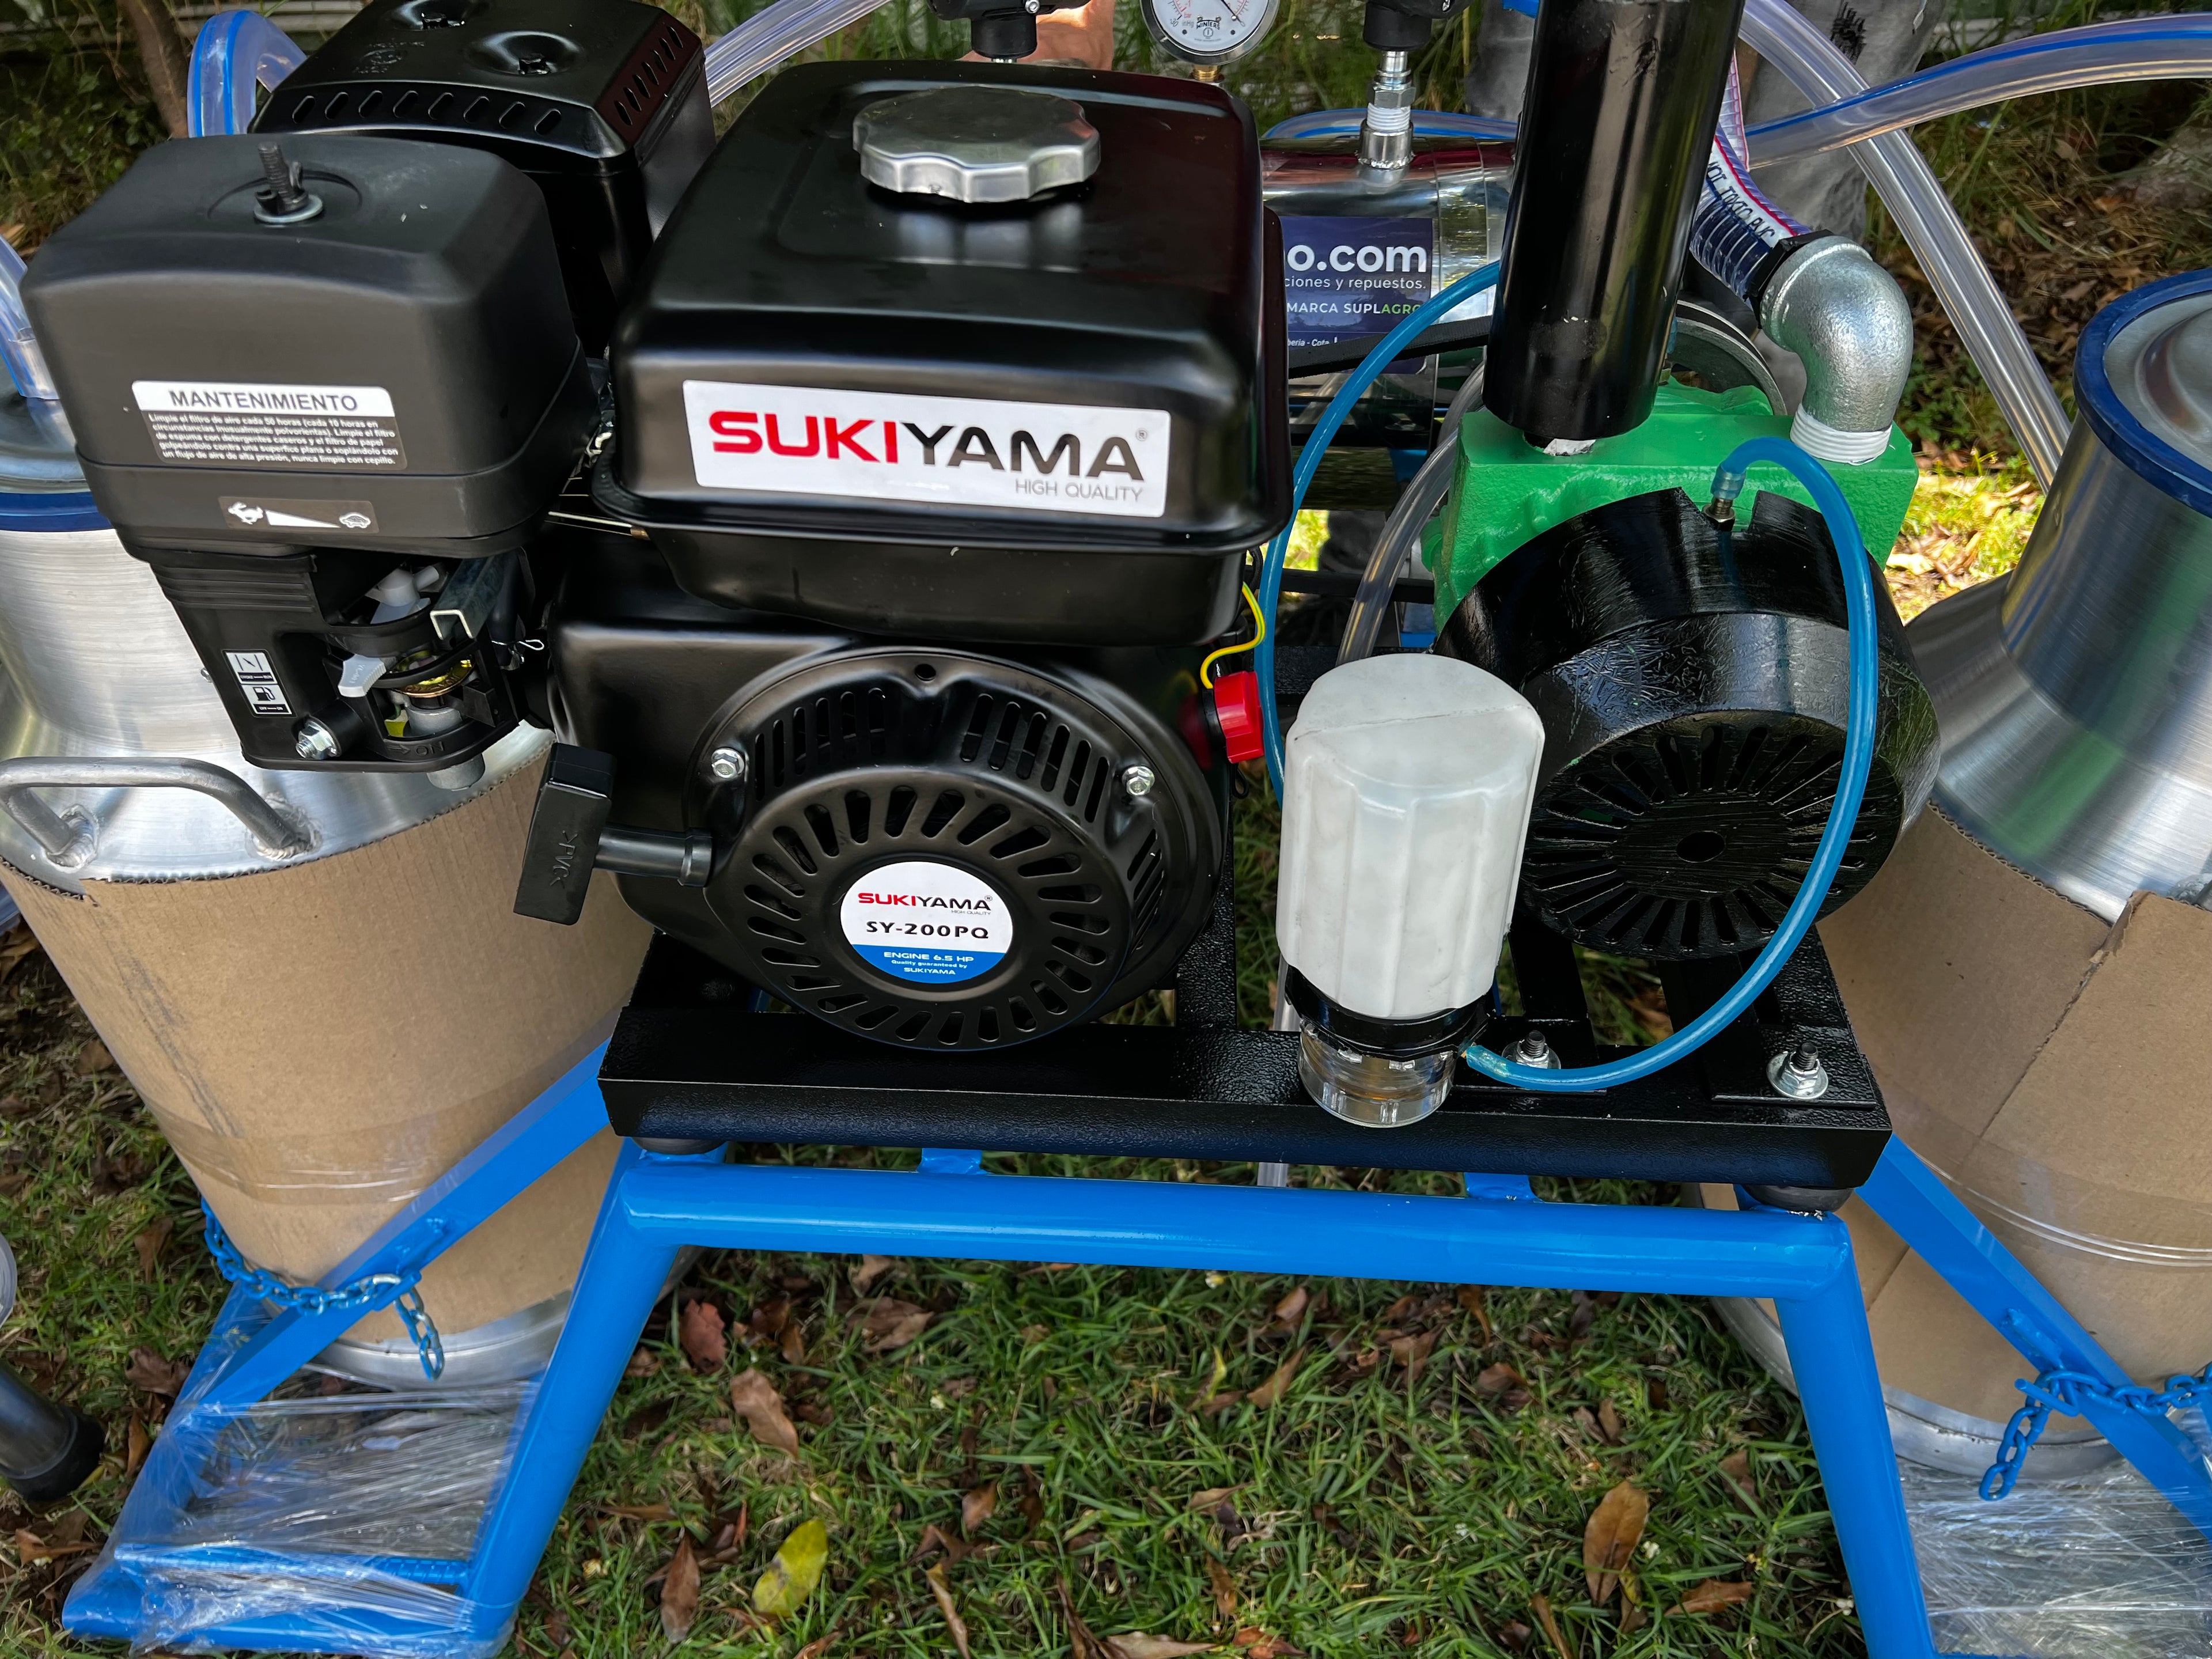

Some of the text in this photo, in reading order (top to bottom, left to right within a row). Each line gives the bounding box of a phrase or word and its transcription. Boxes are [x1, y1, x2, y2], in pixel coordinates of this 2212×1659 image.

[1196, 20, 1220, 30] WINTERS
[1336, 278, 1344, 290] y
[1349, 278, 1426, 290] repuestos.
[1287, 302, 1339, 313] MARCA
[169, 391, 358, 410] MANTENIMIENTO
[148, 412, 179, 424] Limpie
[211, 415, 223, 424] de
[242, 416, 264, 425] cada
[275, 417, 302, 426] horas
[302, 417, 327, 427] (cada
[328, 418, 339, 427] 10
[340, 419, 366, 428] horas
[156, 432, 168, 440] de
[273, 437, 307, 445] caseros
[308, 438, 314, 446] y
[359, 438, 384, 448] papel
[333, 429, 364, 438] Limpie
[374, 429, 396, 438] filtro
[300, 446, 325, 454] plana
[333, 446, 381, 456] soplándolo
[709, 410, 1145, 482] SUKIYAMA
[196, 451, 207, 459] de
[226, 452, 237, 460] de
[238, 452, 255, 460] alta
[291, 454, 319, 463] nunca
[319, 454, 346, 464] limpie
[365, 455, 396, 465] cepillo.
[1016, 478, 1144, 503] HIGH QUALITY
[415, 741, 445, 756] ON
[857, 892, 991, 911] SUKIYAMA
[866, 921, 989, 939] SY-200PQ
[884, 951, 930, 961] ENGINE
